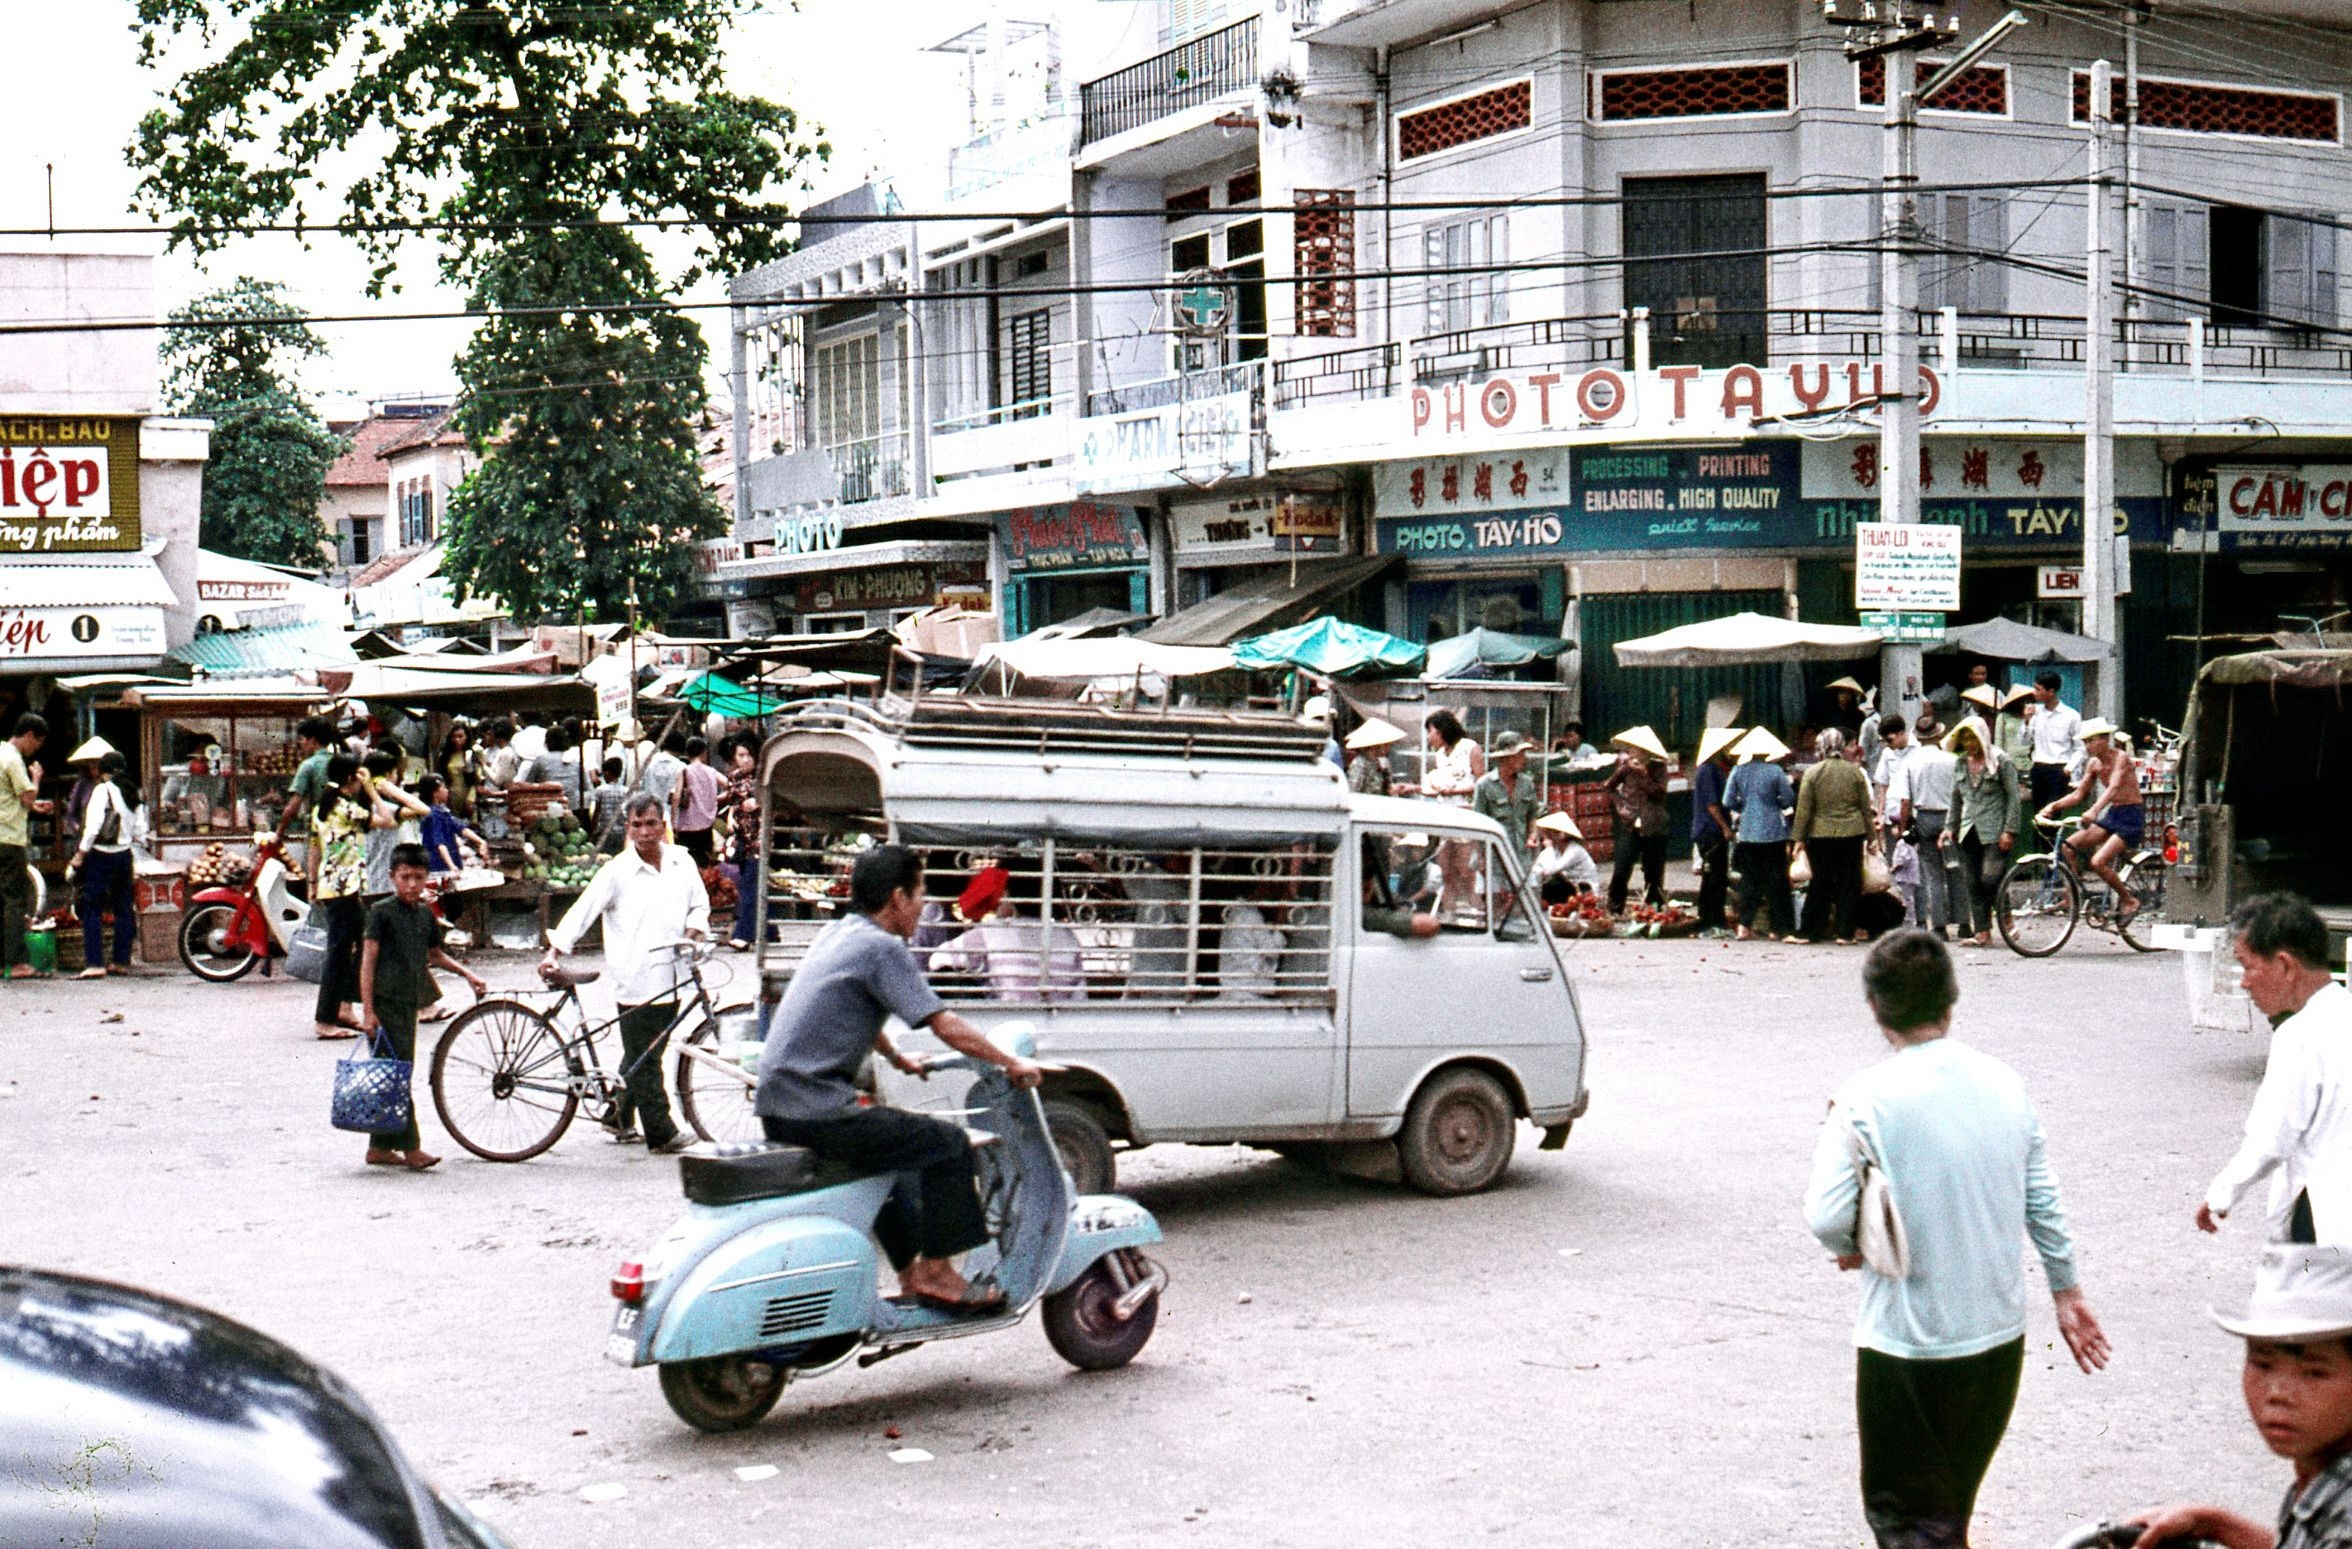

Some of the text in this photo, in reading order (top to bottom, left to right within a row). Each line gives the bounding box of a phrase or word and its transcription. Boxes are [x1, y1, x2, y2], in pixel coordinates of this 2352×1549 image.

[1410, 366, 1627, 436] PHOTO
[1582, 454, 1770, 478] PROCESSING PRINTING
[1679, 487, 1715, 509] HIGH
[1722, 487, 1780, 509] QUALITY
[774, 511, 843, 555] PHOTO
[202, 584, 246, 599] BAZAR
